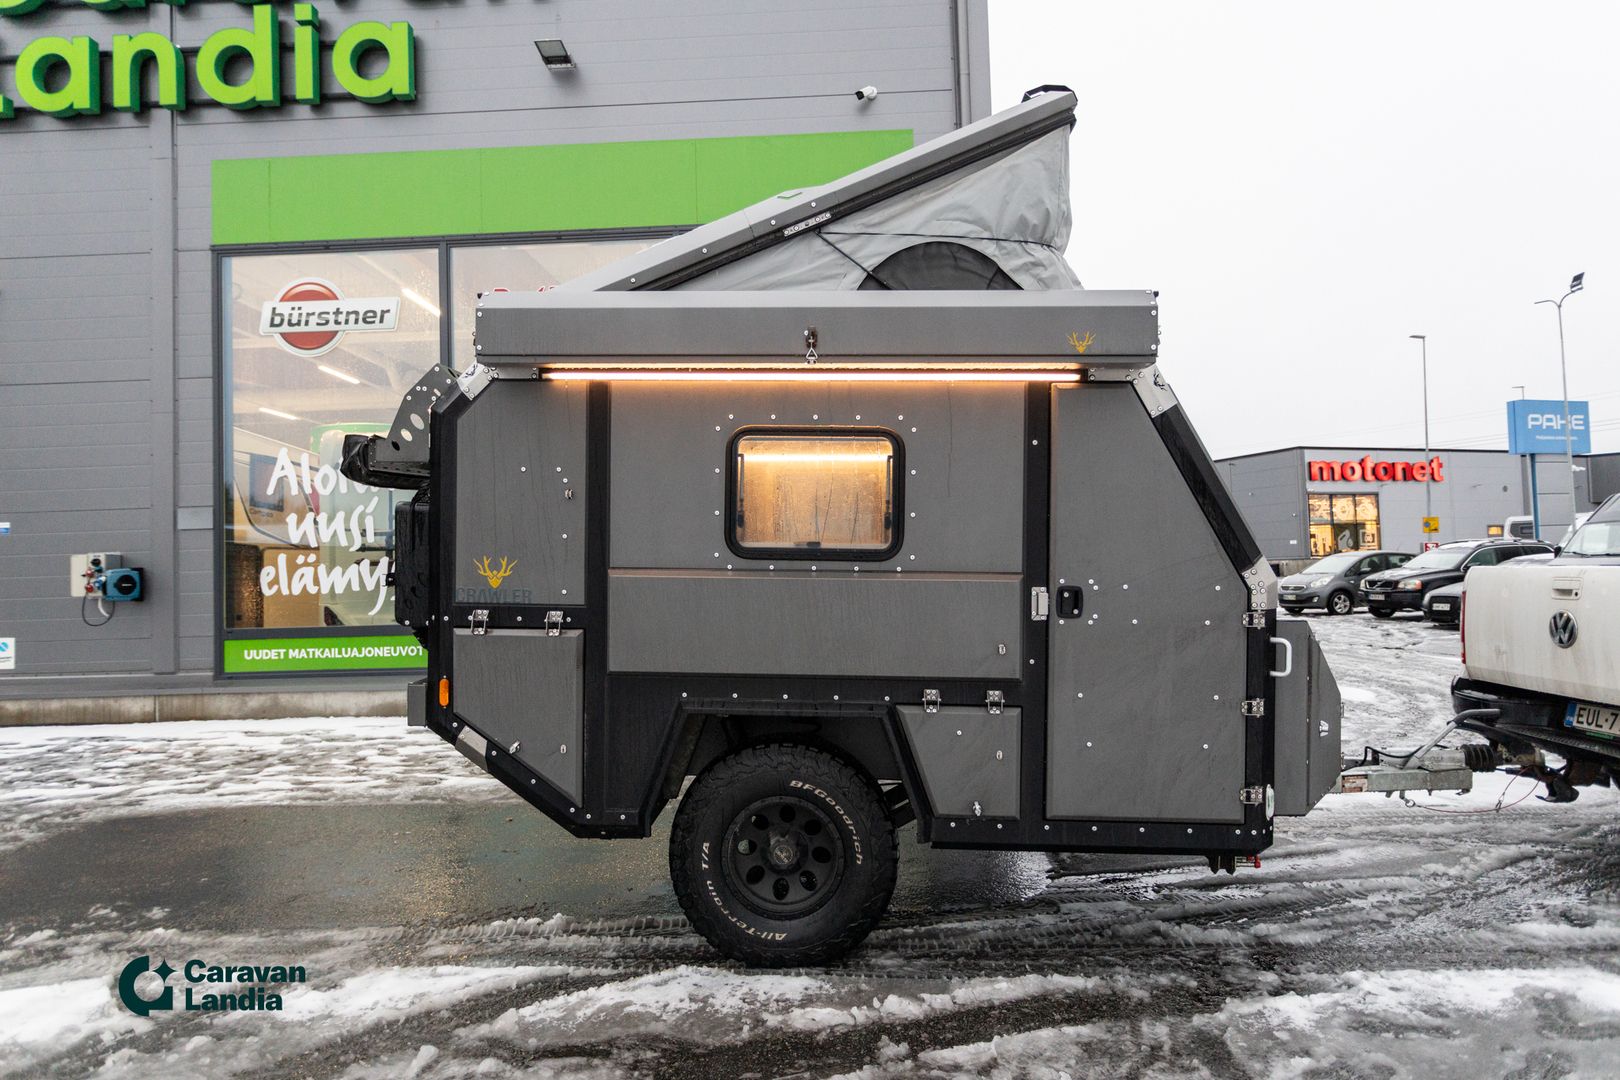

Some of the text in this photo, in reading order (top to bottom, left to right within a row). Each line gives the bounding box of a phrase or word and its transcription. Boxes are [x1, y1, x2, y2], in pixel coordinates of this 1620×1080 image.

[0, 4, 415, 119] andia
[269, 305, 391, 328] bürstner
[266, 447, 394, 496] Aloi
[1308, 454, 1444, 483] motonet
[260, 553, 395, 616] elämy
[455, 587, 533, 603] CRAWLER
[244, 649, 286, 660] UUDET
[1576, 705, 1620, 733] EUL-7
[789, 780, 862, 865] BFGoodrich
[701, 842, 788, 941] All-Terrain T/A
